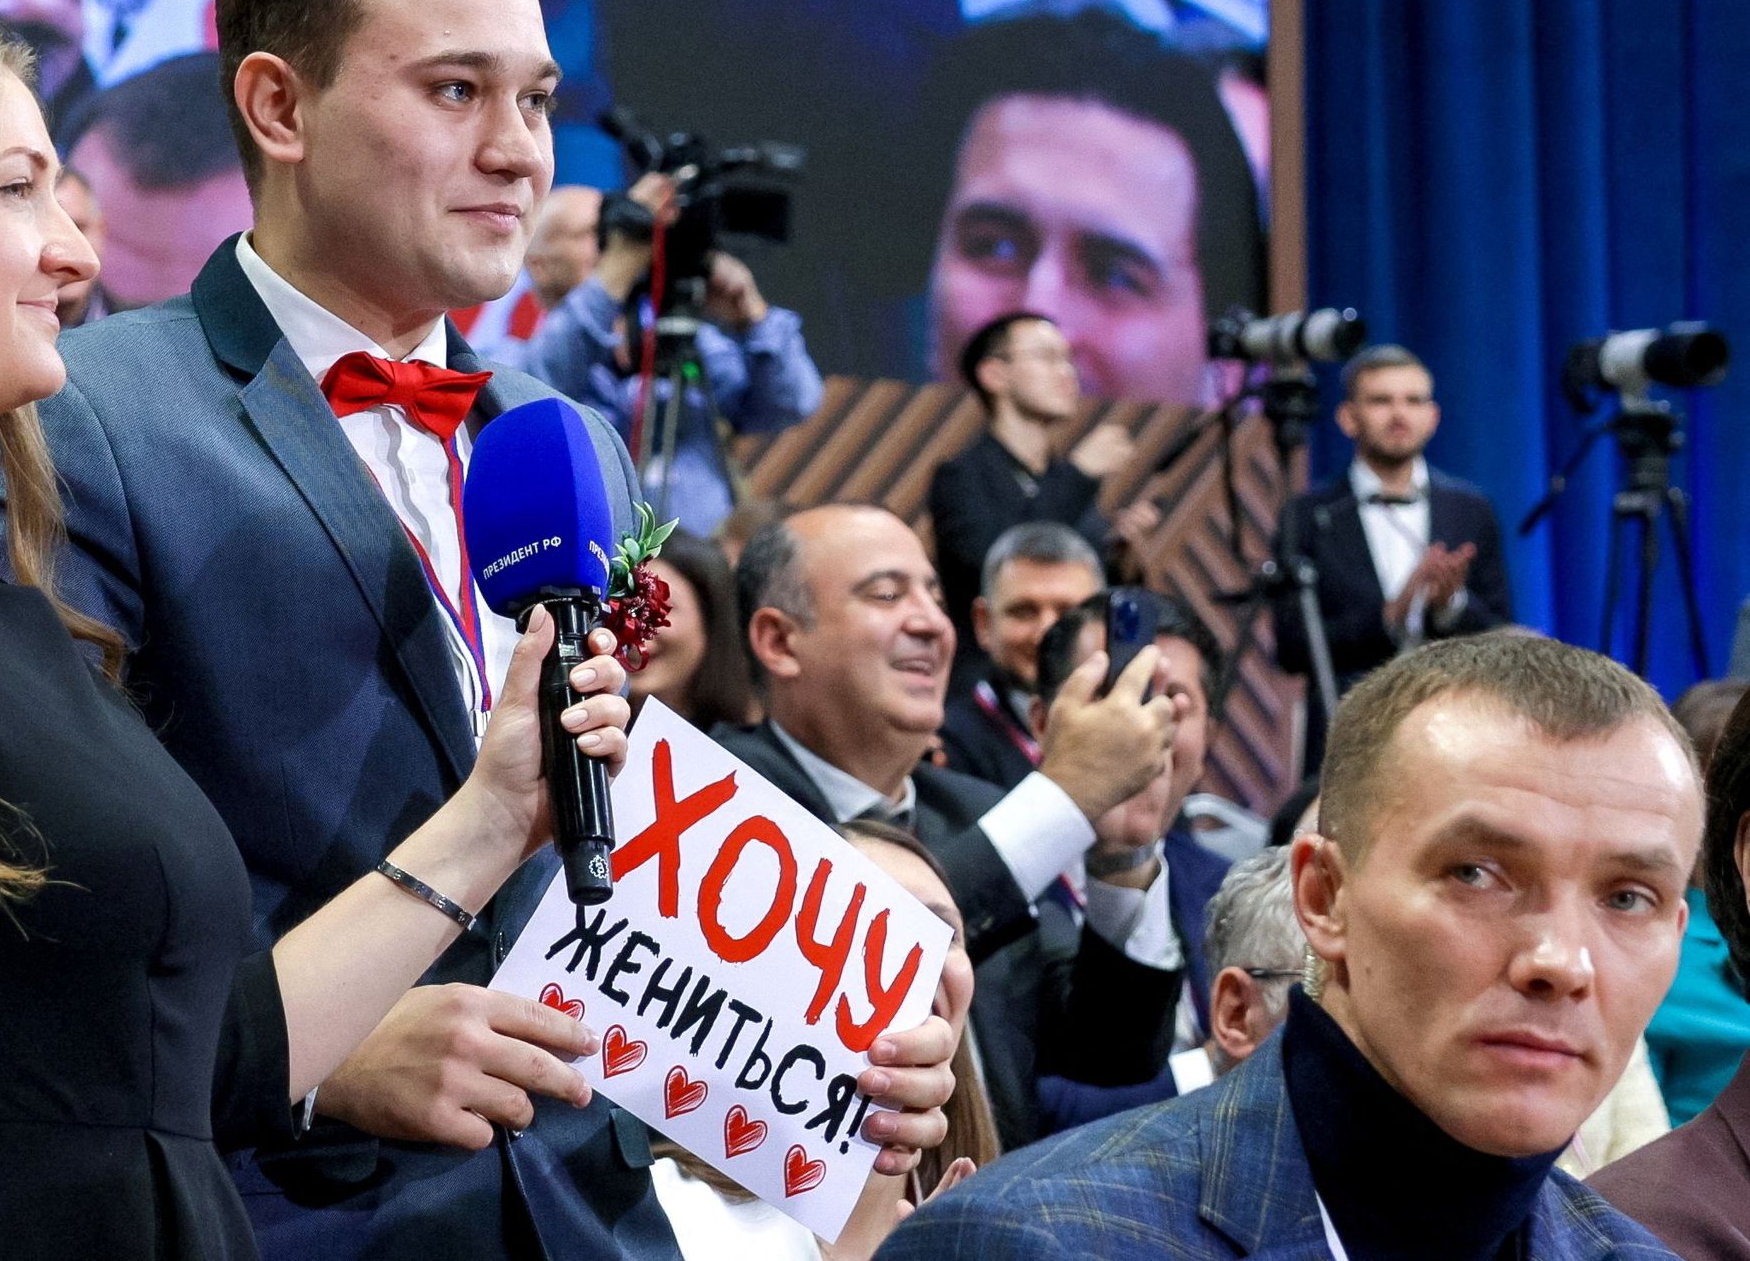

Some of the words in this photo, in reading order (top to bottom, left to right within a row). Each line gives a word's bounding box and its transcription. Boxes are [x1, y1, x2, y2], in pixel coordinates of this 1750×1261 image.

[482, 541, 540, 580] ПРЕЗИДЕНТ
[542, 536, 562, 551] РФ
[609, 737, 924, 1053] ХОЧУ
[544, 903, 874, 1155] ЖЕНИТЬСЯ!
